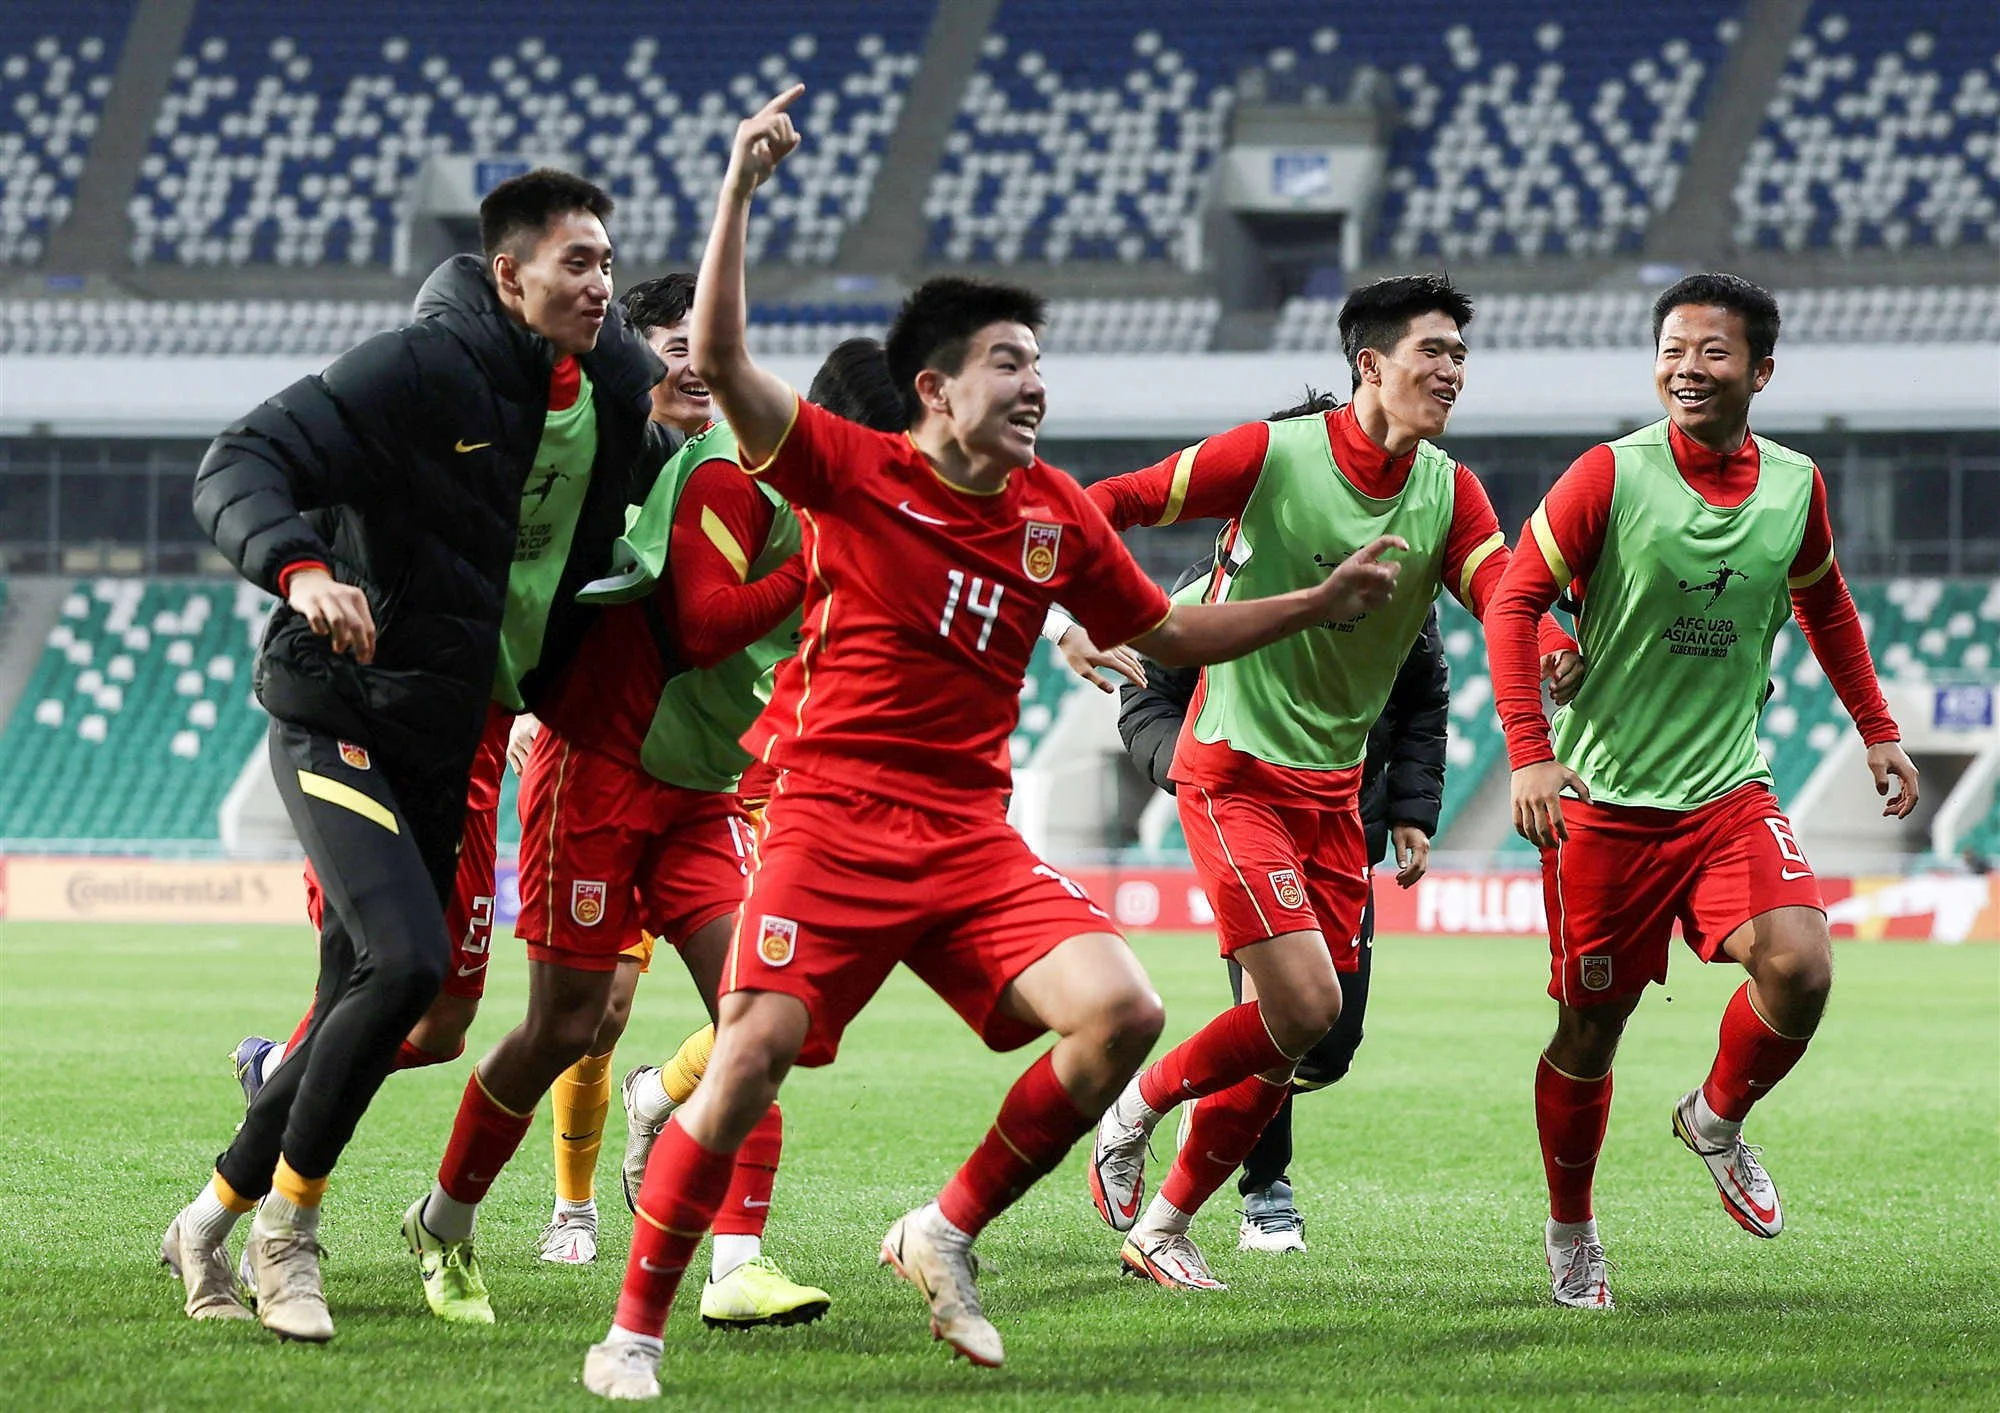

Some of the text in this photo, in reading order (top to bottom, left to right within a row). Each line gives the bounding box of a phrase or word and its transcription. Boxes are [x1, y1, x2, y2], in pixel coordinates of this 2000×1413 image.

[1031, 527, 1057, 539] CFA
[940, 569, 1004, 651] 14
[1673, 616, 1734, 632] AFC U20
[1661, 628, 1738, 646] ASIAN CUP
[1274, 874, 1294, 883] CFA
[66, 870, 241, 914] Continental
[577, 885, 602, 894] CFA
